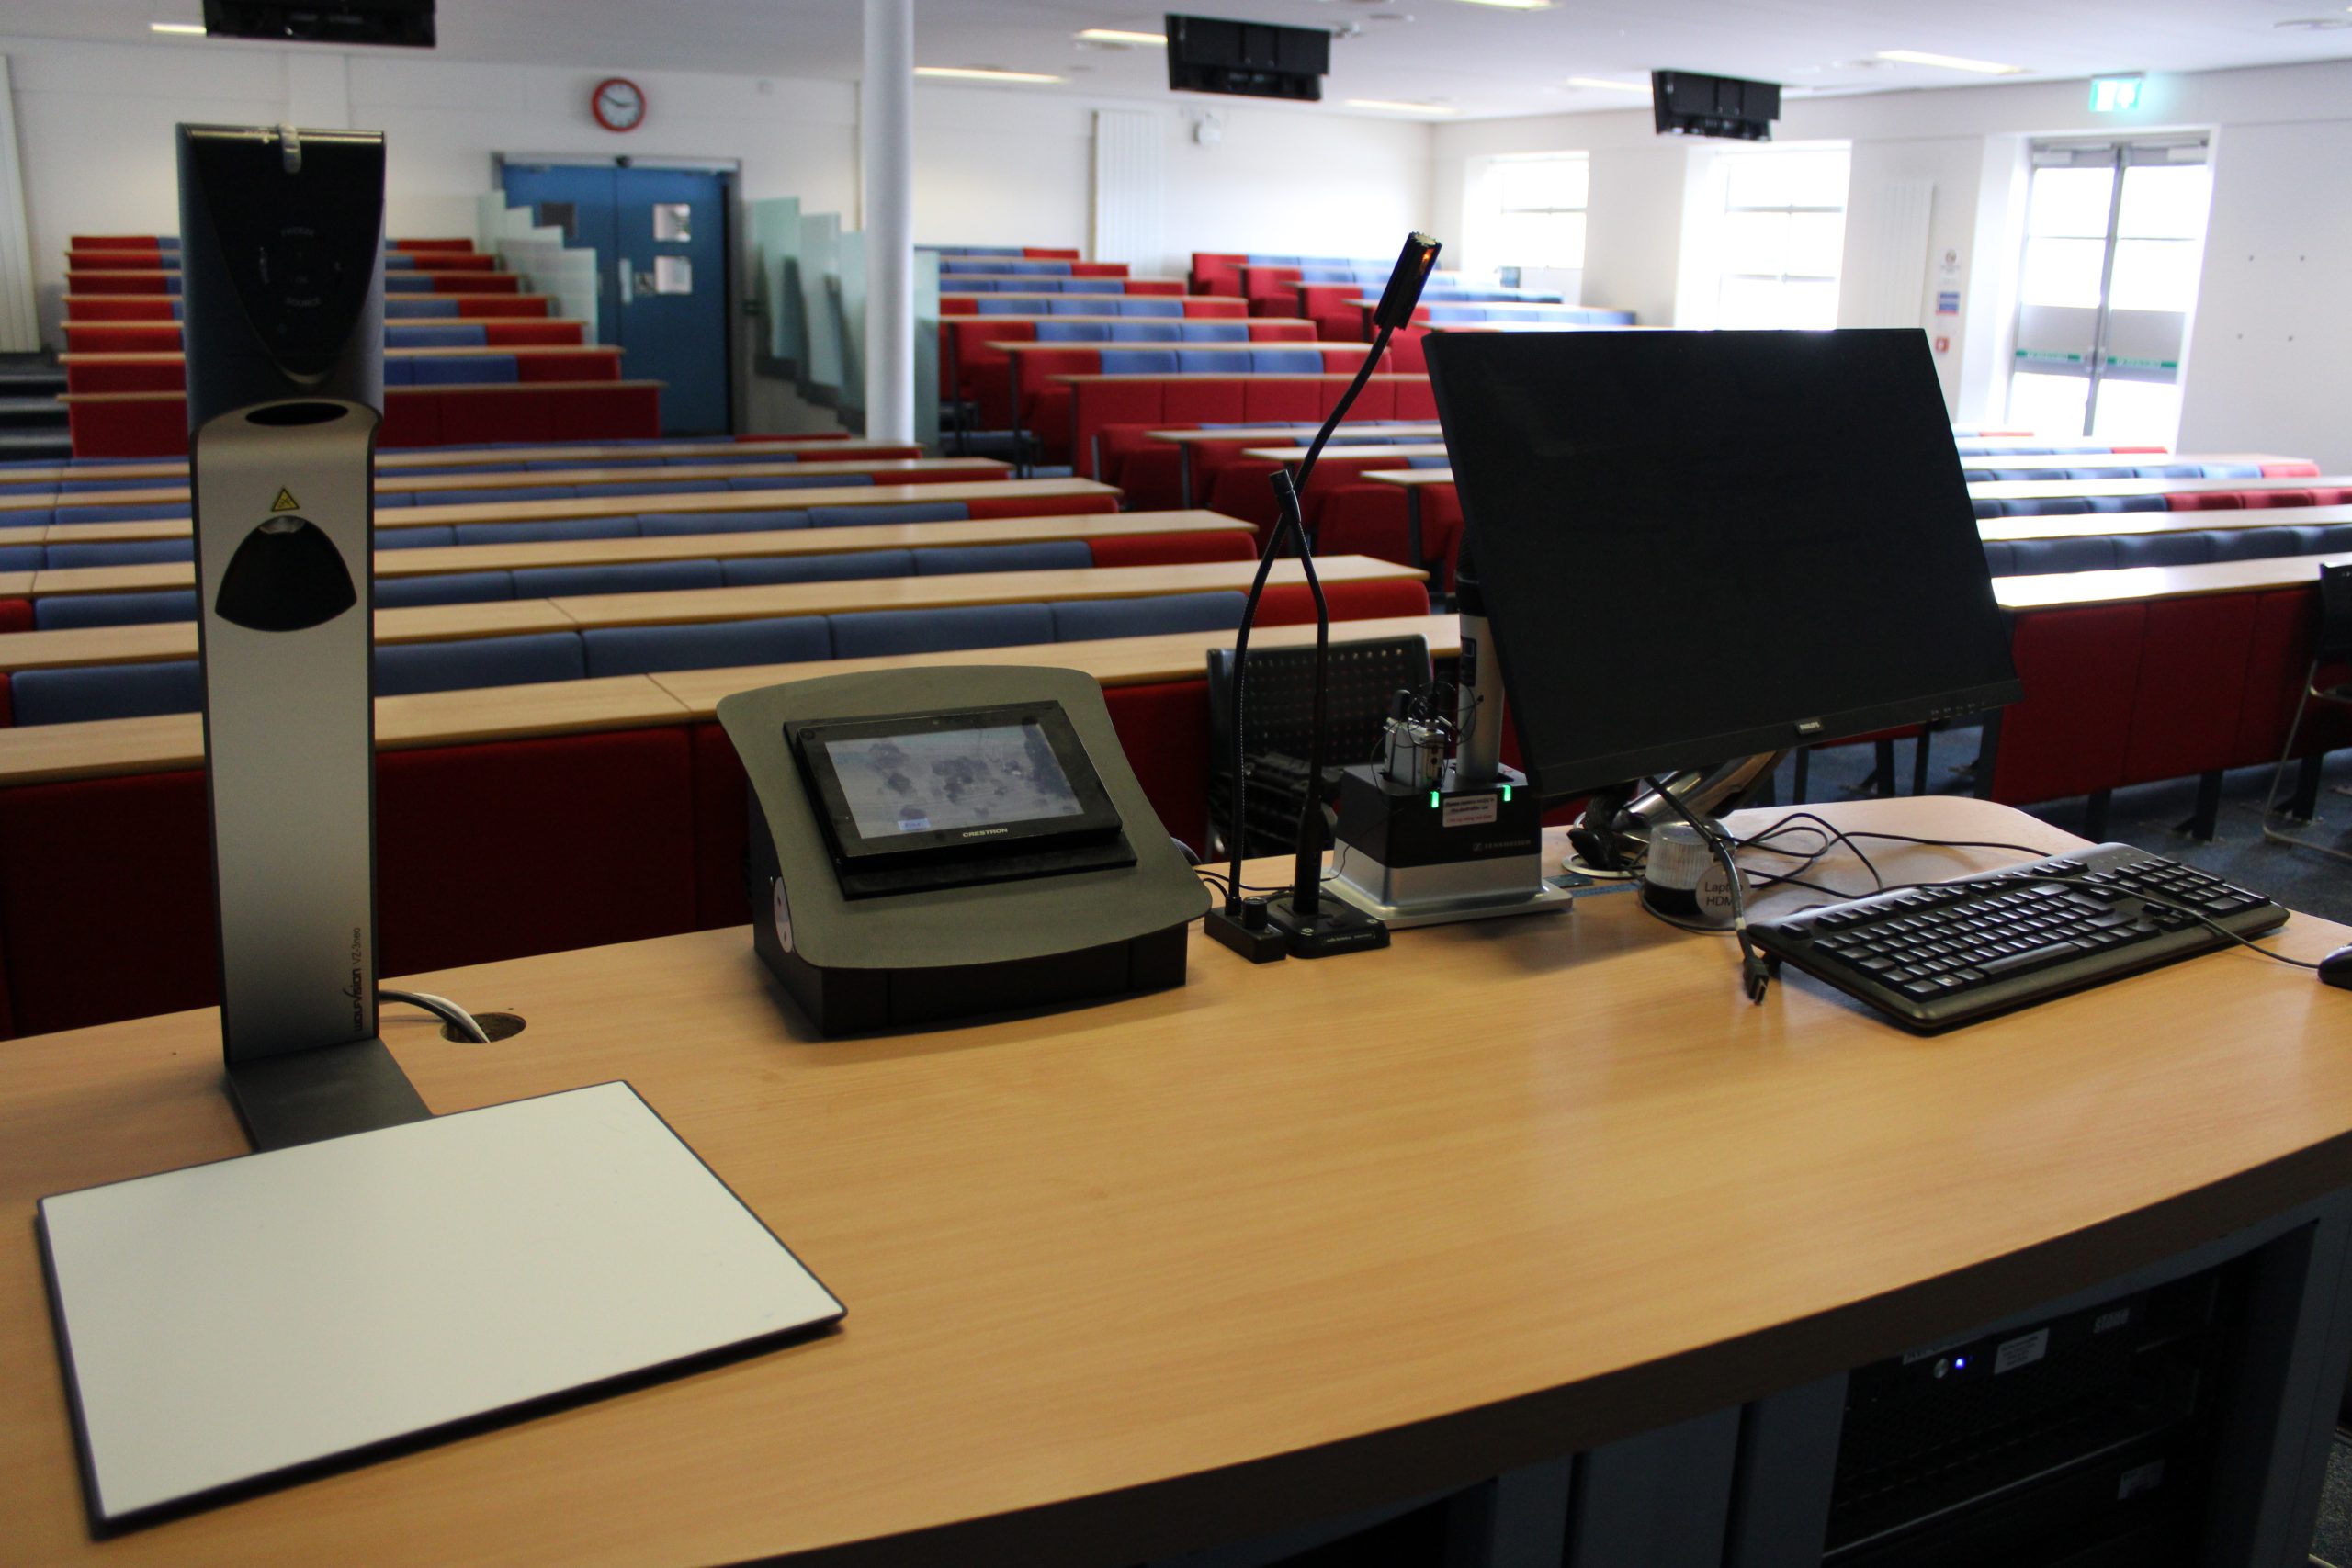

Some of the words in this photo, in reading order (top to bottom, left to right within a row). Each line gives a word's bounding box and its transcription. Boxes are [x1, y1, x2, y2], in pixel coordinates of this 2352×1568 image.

[962, 827, 1009, 838] CRESTRON
[1704, 881, 1744, 894] Lapt
[1706, 896, 1734, 907] HDM
[352, 927, 363, 964] VZ-3neo
